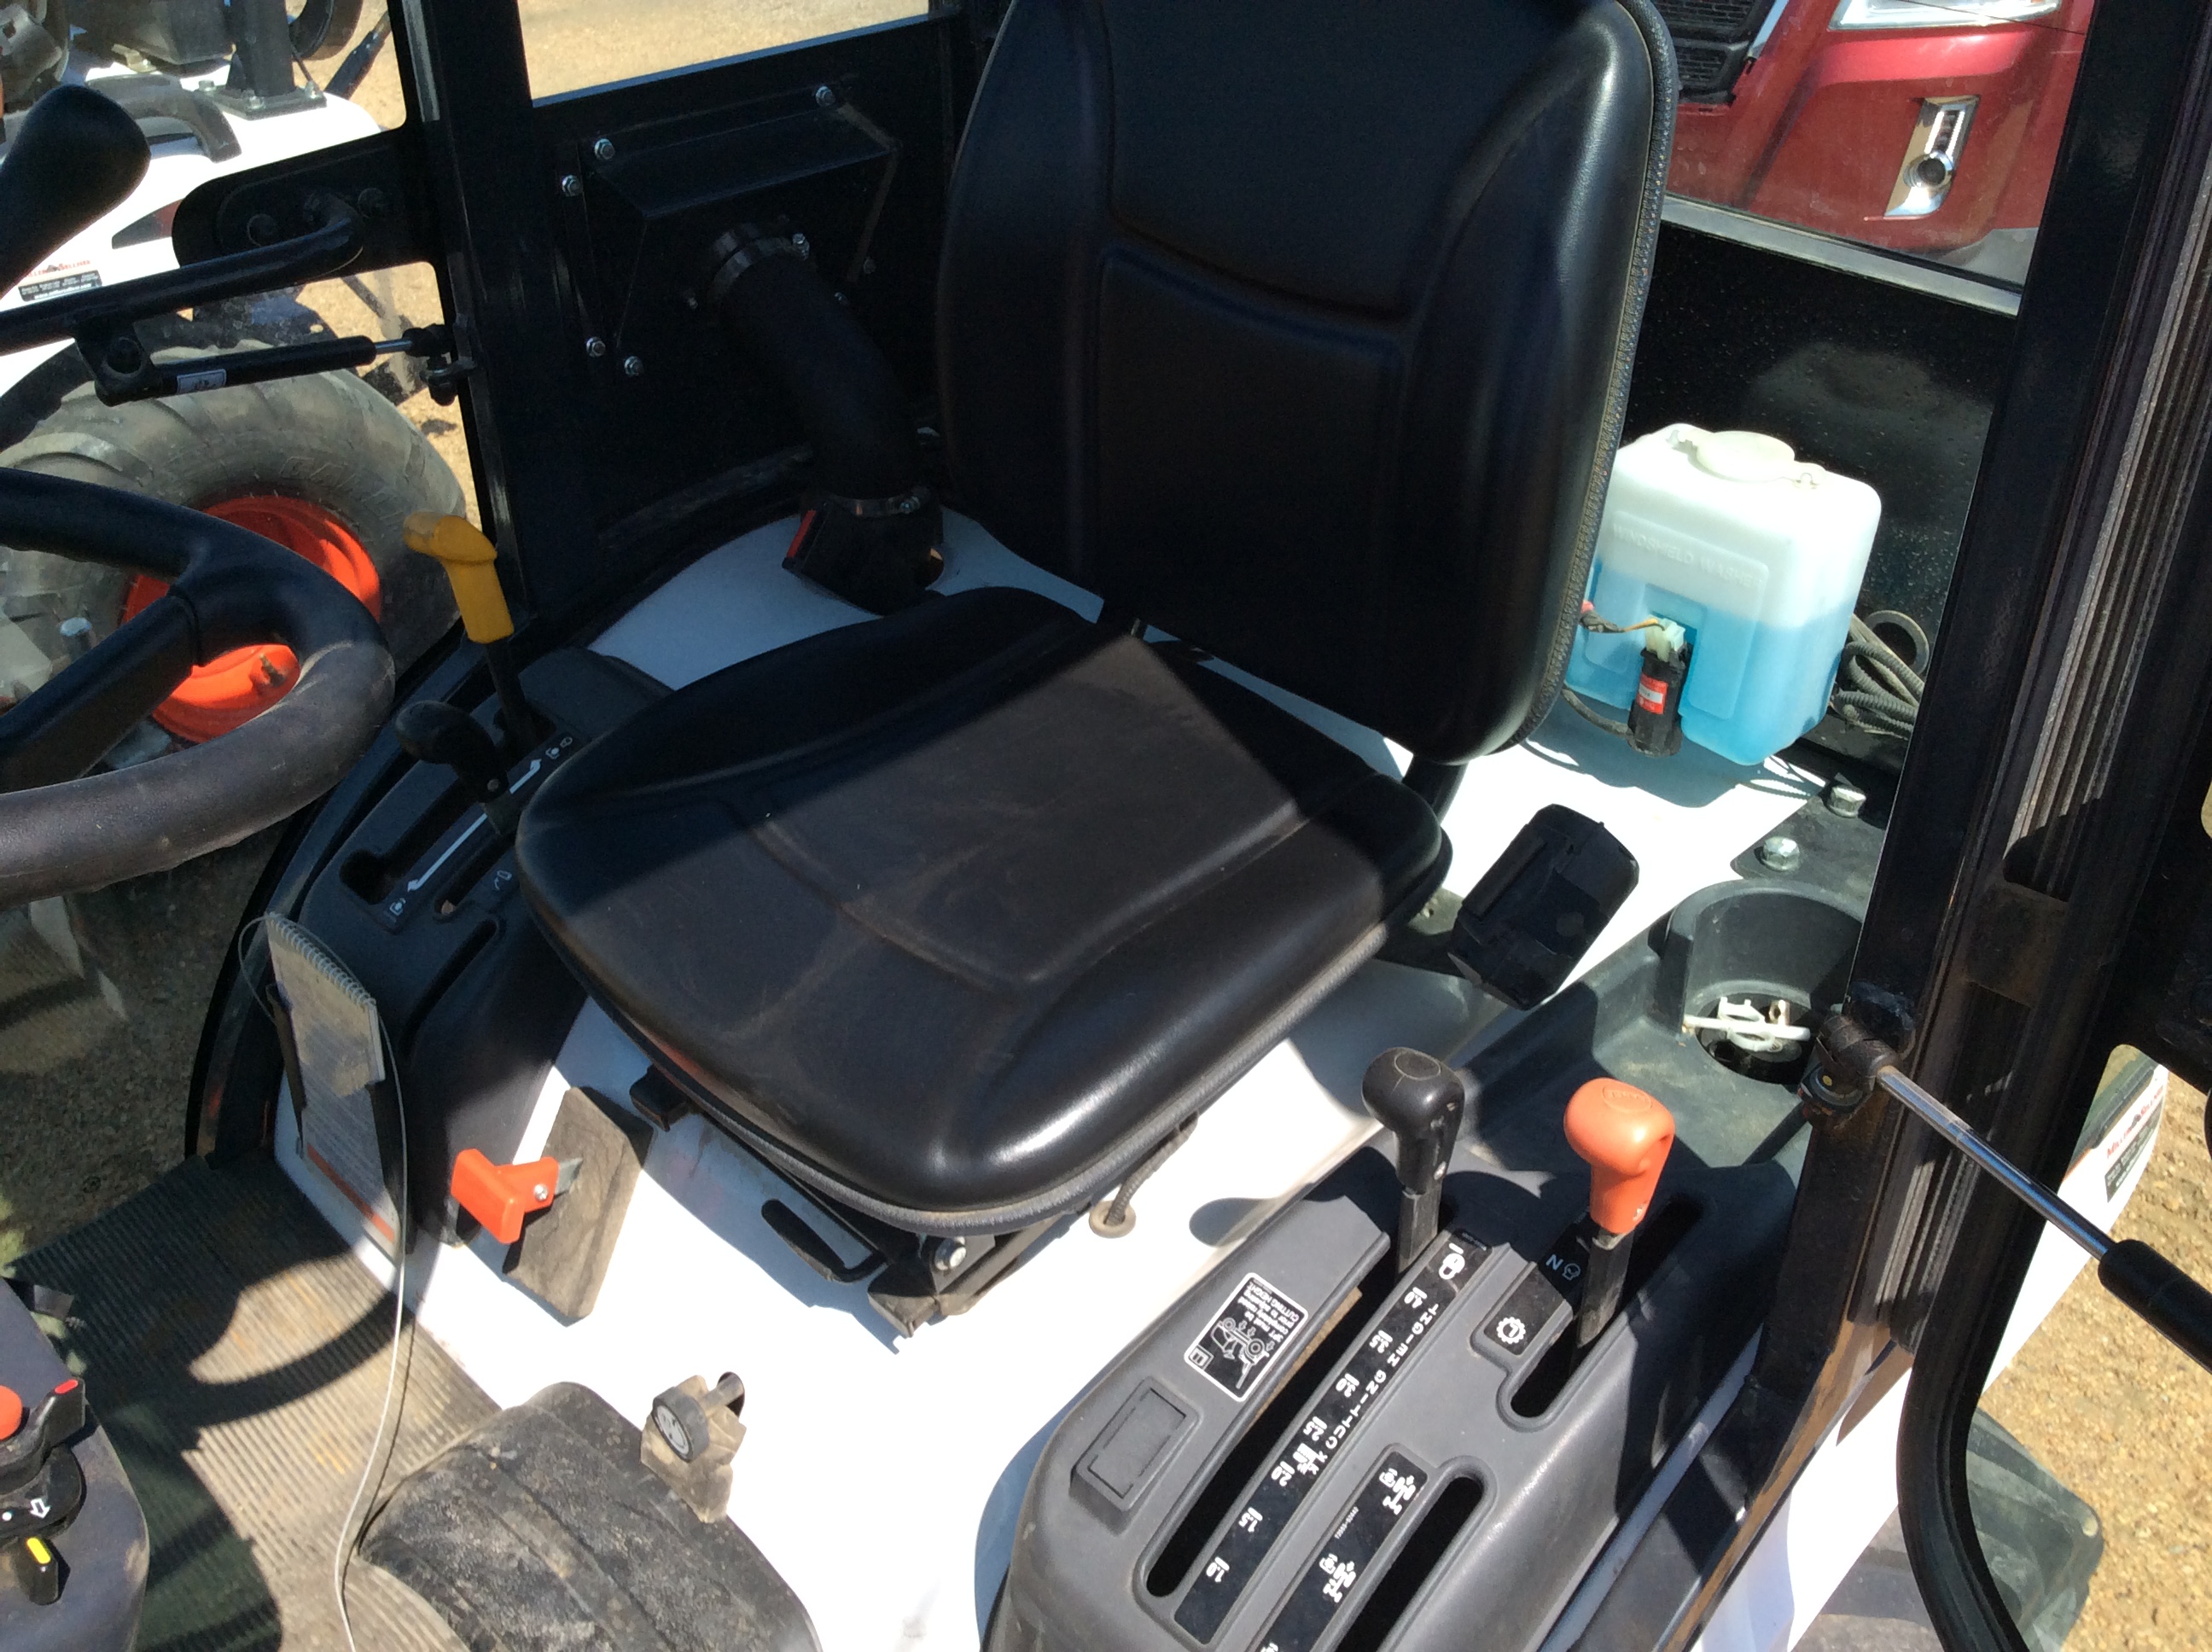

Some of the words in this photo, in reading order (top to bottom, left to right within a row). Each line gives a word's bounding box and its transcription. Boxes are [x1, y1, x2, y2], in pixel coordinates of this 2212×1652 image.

[1612, 523, 1694, 565] WINDSHIELD
[1545, 1254, 1564, 1271] N
[1270, 1298, 1300, 1323] CUTTING
[1325, 1370, 1387, 1449] CUTTING
[1387, 1304, 1440, 1367] HEIGHT
